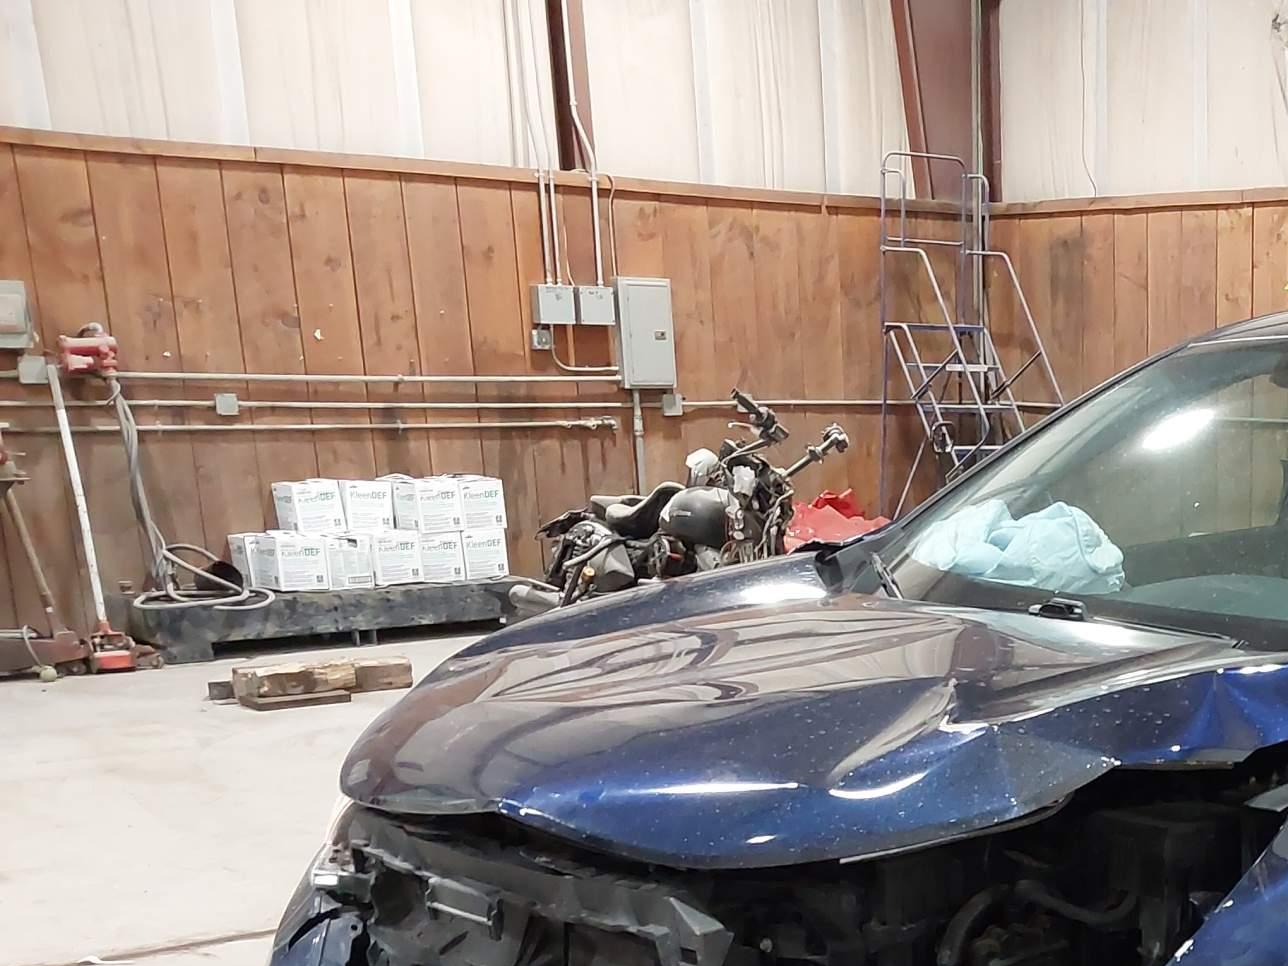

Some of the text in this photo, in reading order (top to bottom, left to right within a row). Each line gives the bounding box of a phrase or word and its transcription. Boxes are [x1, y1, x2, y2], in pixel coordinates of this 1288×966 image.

[350, 491, 388, 500] KleenDEF
[420, 490, 456, 501] KleenDEF
[463, 489, 500, 500] KleenDEF
[379, 542, 416, 552] KleenDEF
[422, 541, 458, 551] KleenDEF
[465, 538, 502, 549] KleenDEF
[281, 546, 321, 557] KleenDEF
